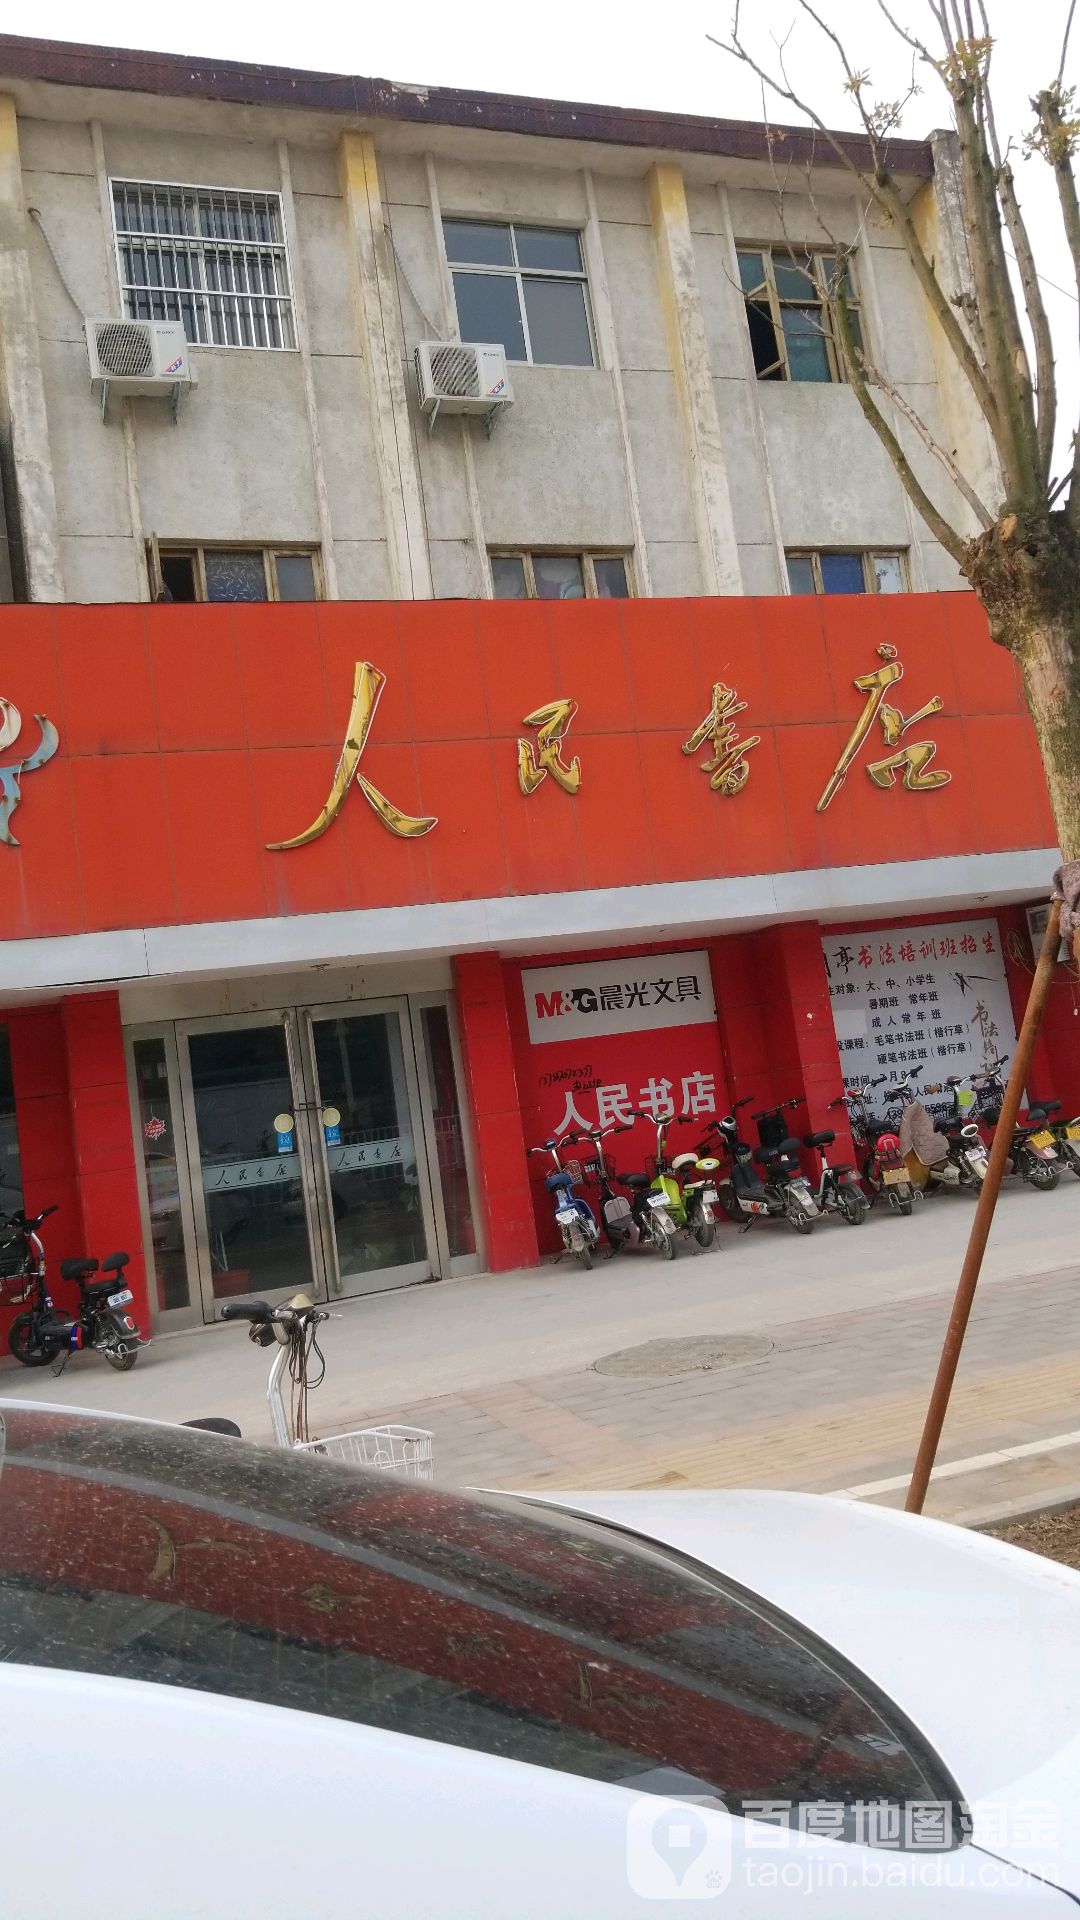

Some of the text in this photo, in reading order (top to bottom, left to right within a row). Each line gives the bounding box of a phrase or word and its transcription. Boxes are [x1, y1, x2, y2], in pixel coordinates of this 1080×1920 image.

[823, 931, 996, 978] 亭书法培训班招生
[535, 976, 701, 1019] M&G 晨光文具
[869, 990, 940, 1011] 暑期班 常年班
[554, 1070, 716, 1135] 人民书店
